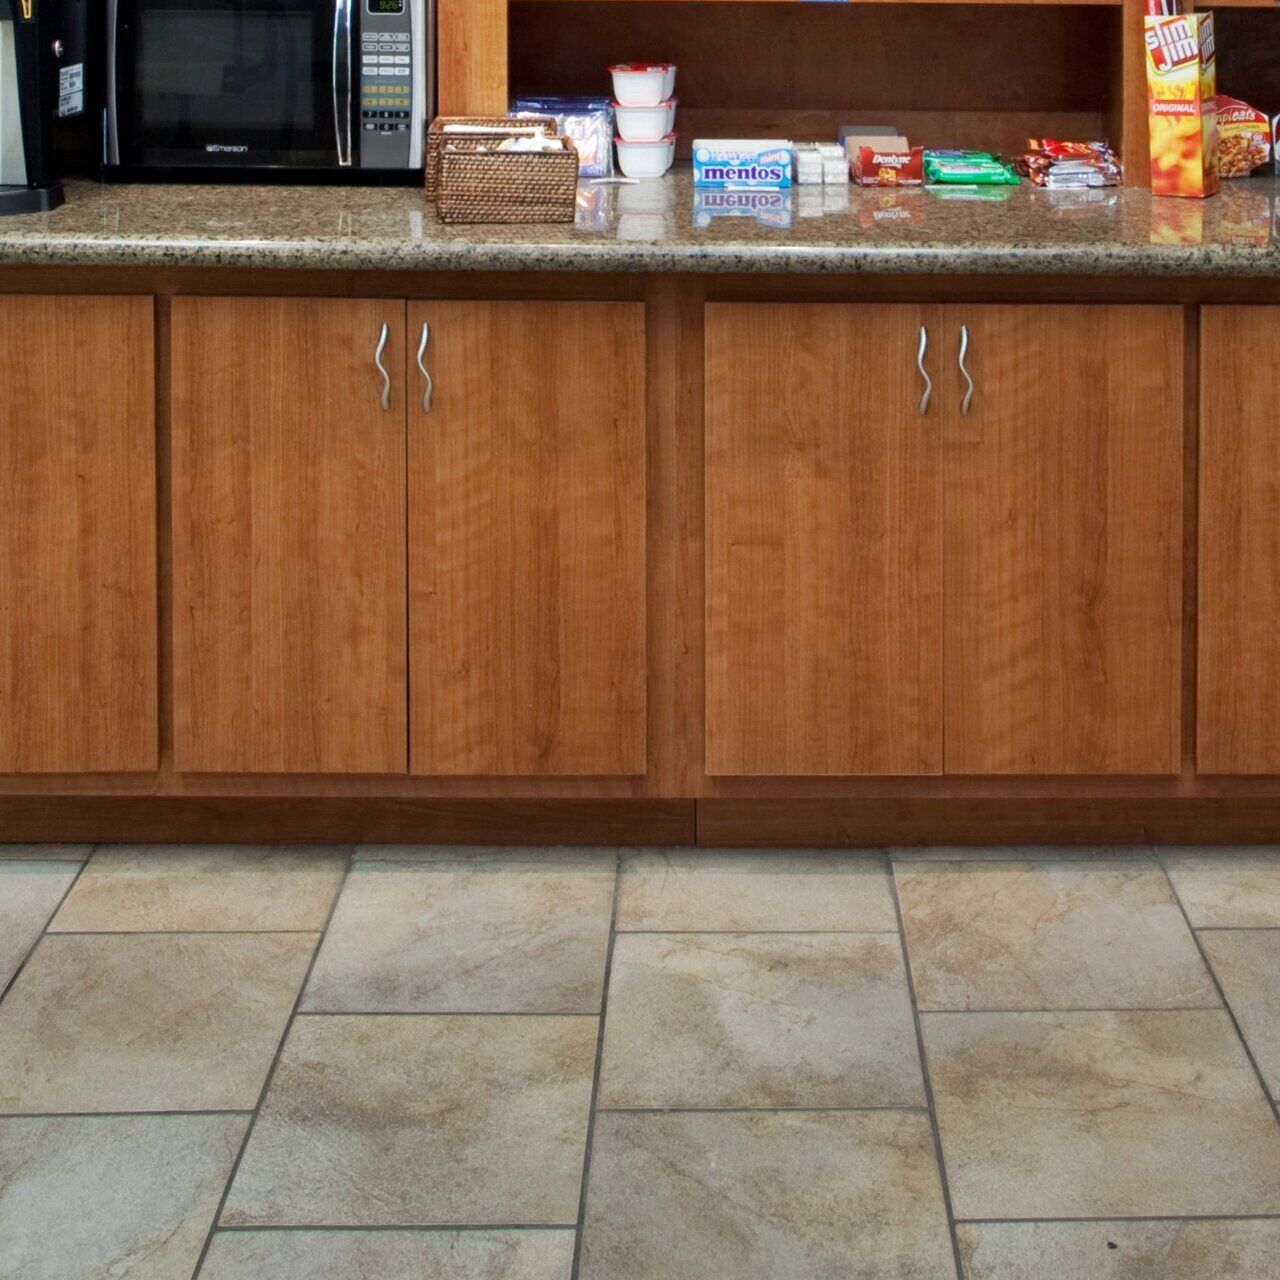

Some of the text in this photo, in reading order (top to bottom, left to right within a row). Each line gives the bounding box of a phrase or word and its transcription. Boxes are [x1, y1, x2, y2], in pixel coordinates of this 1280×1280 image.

[1152, 103, 1197, 114] ORIGINAL
[871, 154, 912, 167] Dentyne
[703, 164, 782, 182] mentos
